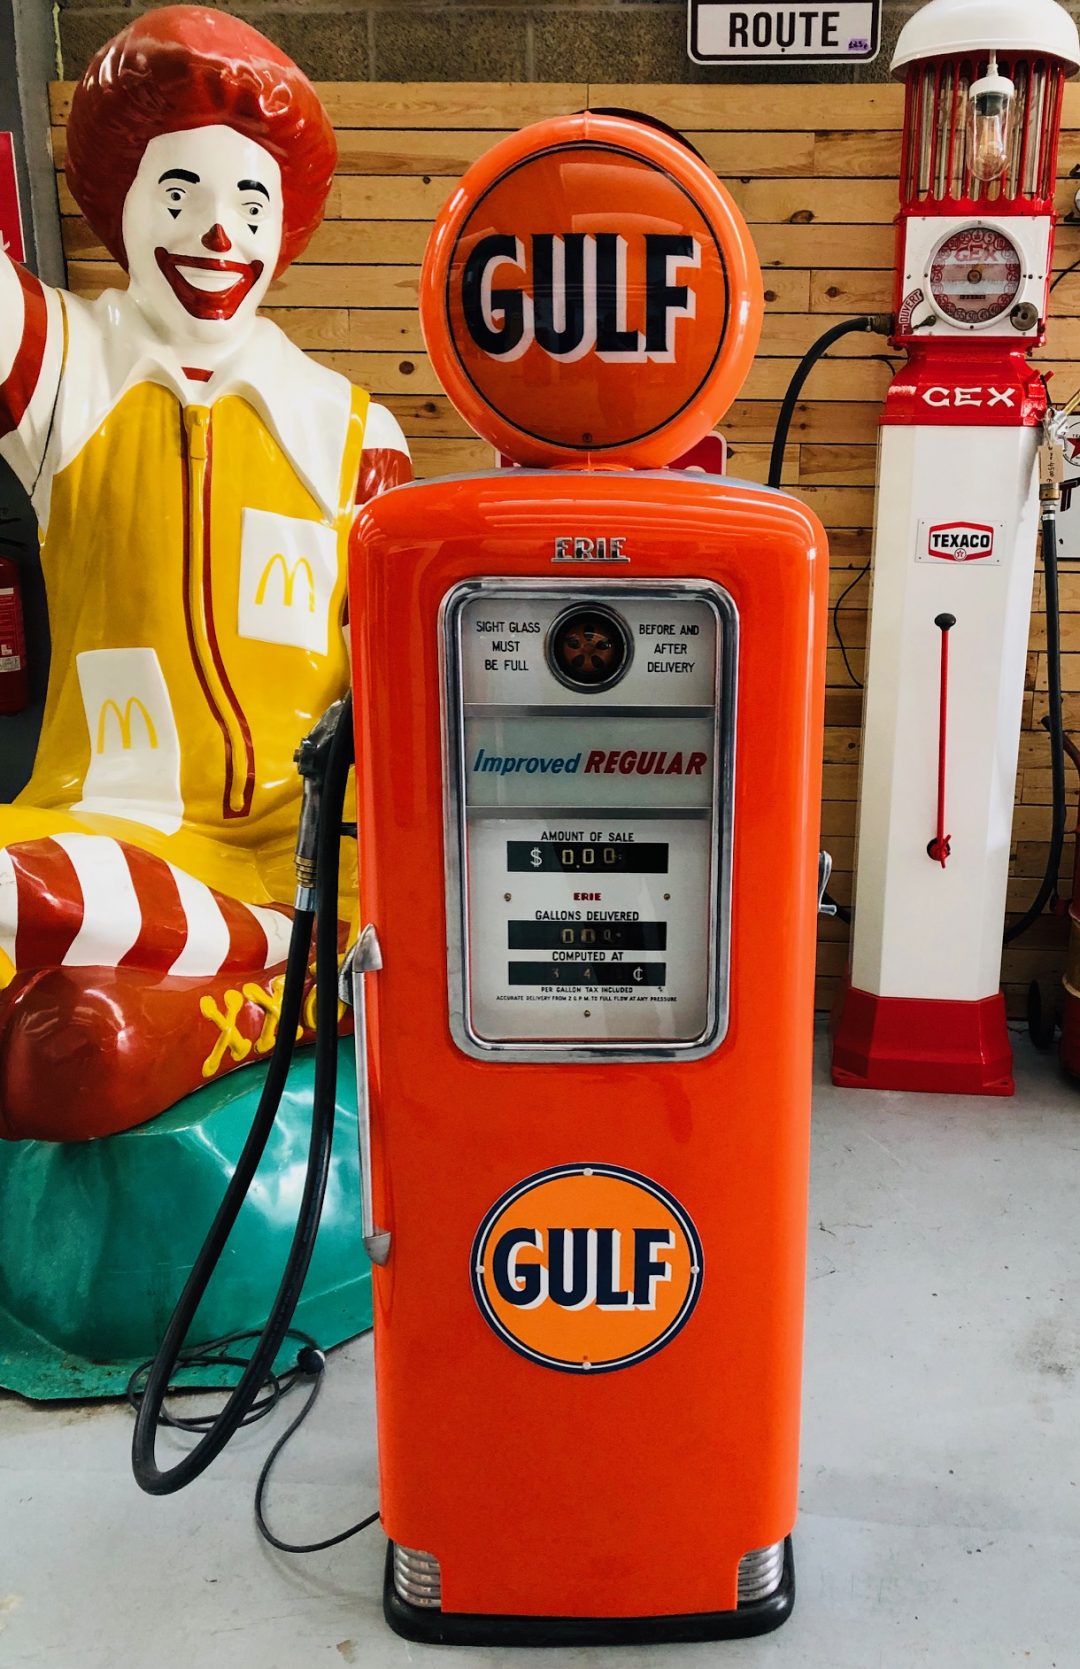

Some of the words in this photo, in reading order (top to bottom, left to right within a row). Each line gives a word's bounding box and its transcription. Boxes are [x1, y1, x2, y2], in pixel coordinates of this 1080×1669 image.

[729, 12, 840, 48] ROUTE
[462, 233, 701, 363] GULF
[922, 387, 1015, 407] GEX
[932, 534, 990, 548] TEXACO
[554, 537, 629, 559] ERIE
[476, 621, 505, 633] SIGHT
[509, 622, 540, 633] GLASS
[639, 624, 676, 635] BEFORE
[680, 624, 699, 635] AND
[492, 641, 520, 652] MUST
[654, 643, 687, 654] AFTER
[485, 659, 498, 670] BE
[504, 660, 528, 671] FULL
[647, 662, 695, 673] DELIVERY
[473, 749, 581, 775] Improved
[584, 750, 707, 775] REGULAR
[540, 831, 584, 841] AMOUNT
[590, 832, 602, 841] OF
[608, 832, 634, 842] SALE
[530, 847, 543, 867] $
[573, 892, 602, 901] ERIE
[535, 910, 581, 921] GALLONS
[586, 911, 639, 921] DELIVERED
[552, 951, 605, 961] COMPUTED
[611, 952, 624, 961] AT
[492, 1227, 676, 1312] GULF
